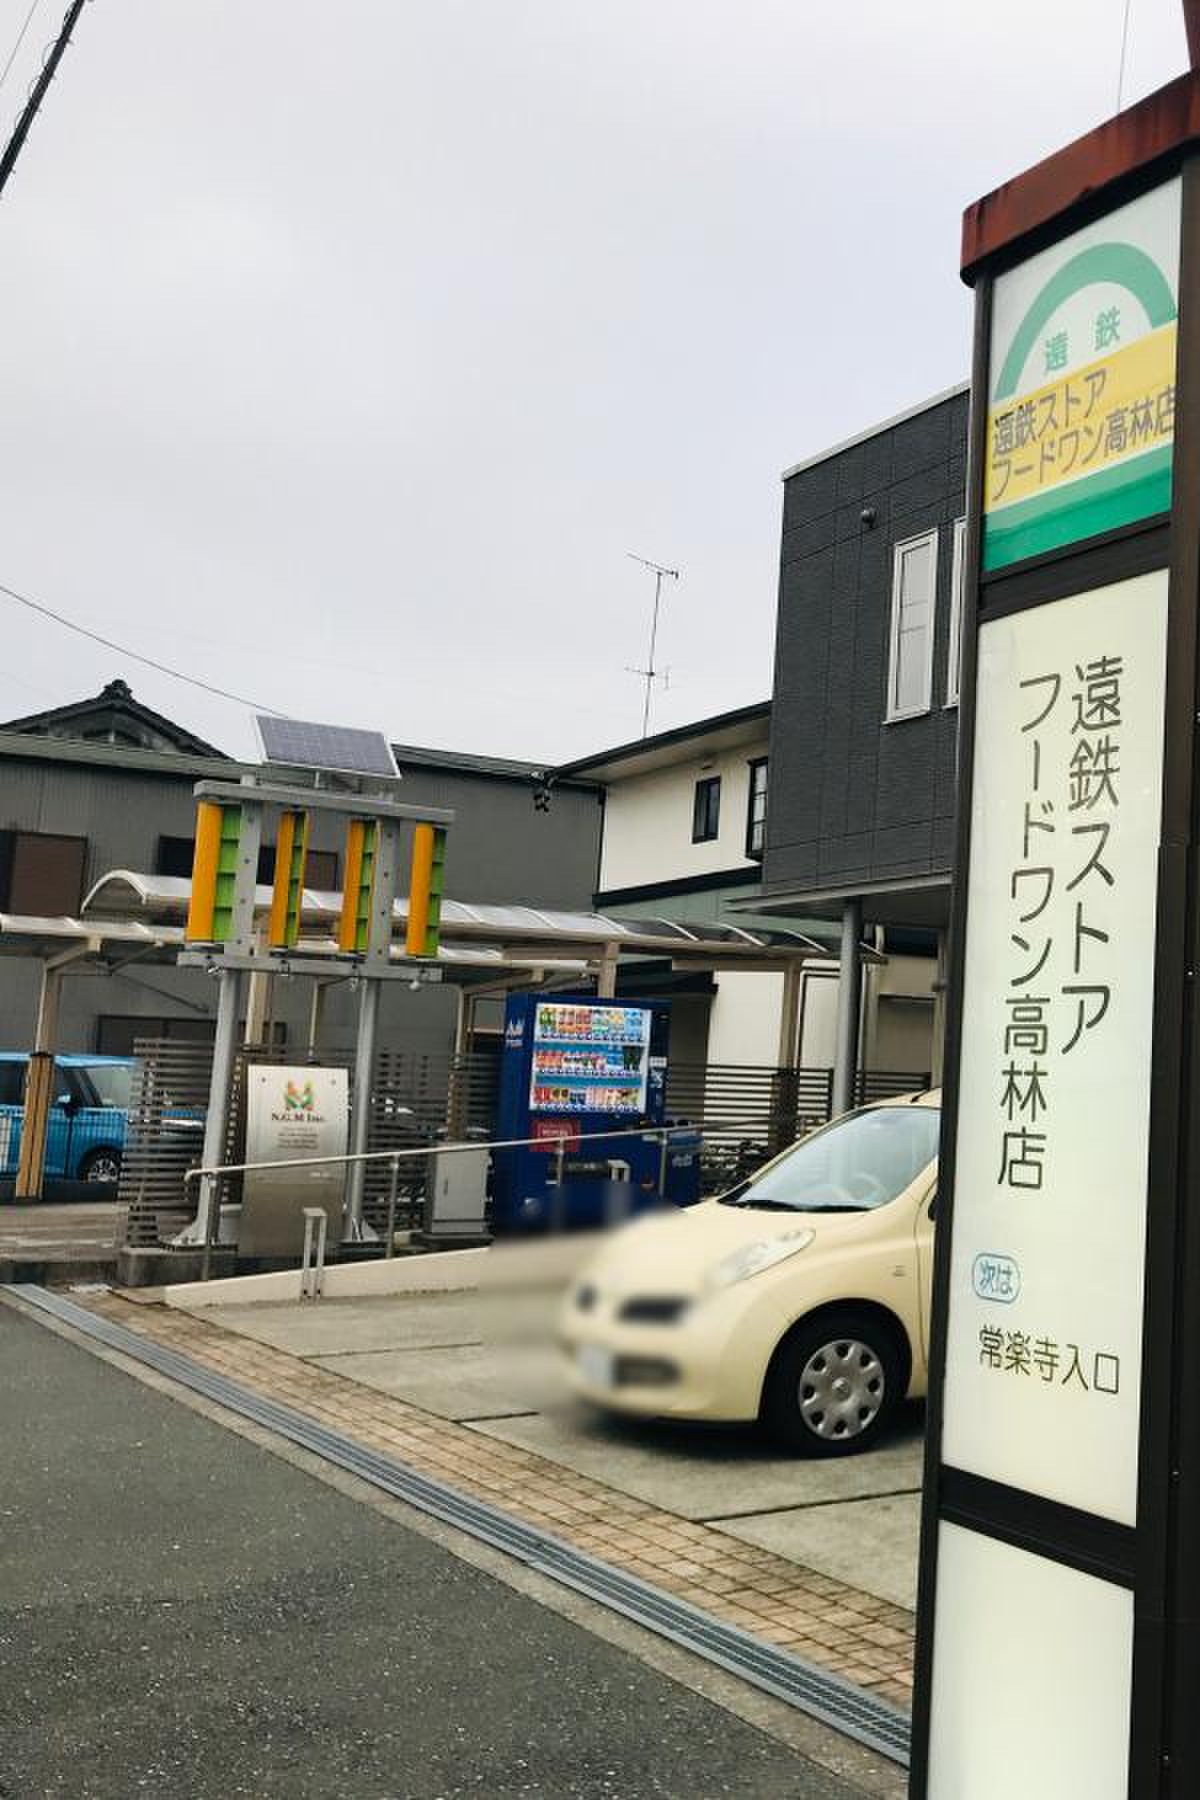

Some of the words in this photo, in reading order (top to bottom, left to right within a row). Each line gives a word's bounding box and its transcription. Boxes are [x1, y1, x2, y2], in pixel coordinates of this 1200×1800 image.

[1045, 306, 1121, 371] 遠鉄
[992, 383, 1175, 501] フードワン高林店
[993, 368, 1107, 455] 遠鉄ストア
[1061, 655, 1124, 1056] 遠鉄ストア
[998, 673, 1062, 1191] フードワン高林店
[979, 1323, 1120, 1395] 常楽寺入口
